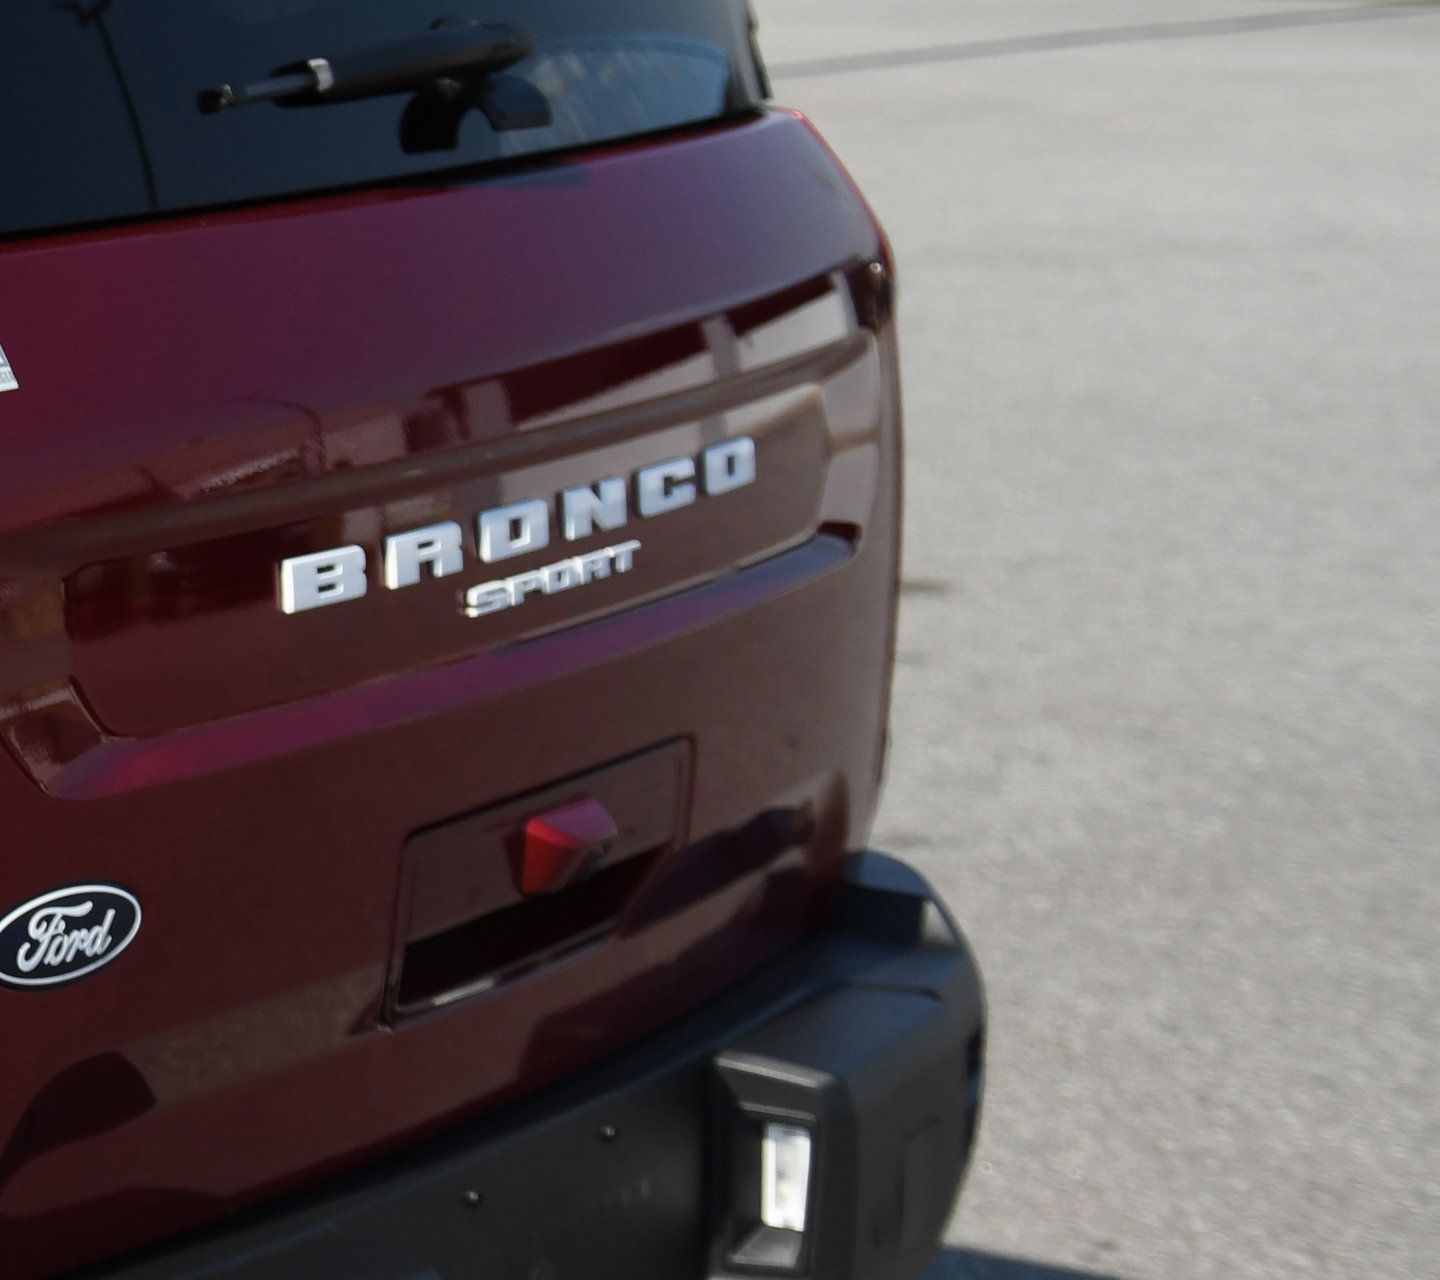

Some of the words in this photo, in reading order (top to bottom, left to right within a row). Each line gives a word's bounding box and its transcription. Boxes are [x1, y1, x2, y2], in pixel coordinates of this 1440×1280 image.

[280, 436, 756, 614] BRONCO
[465, 539, 642, 617] SPORT
[17, 901, 116, 972] Ford
